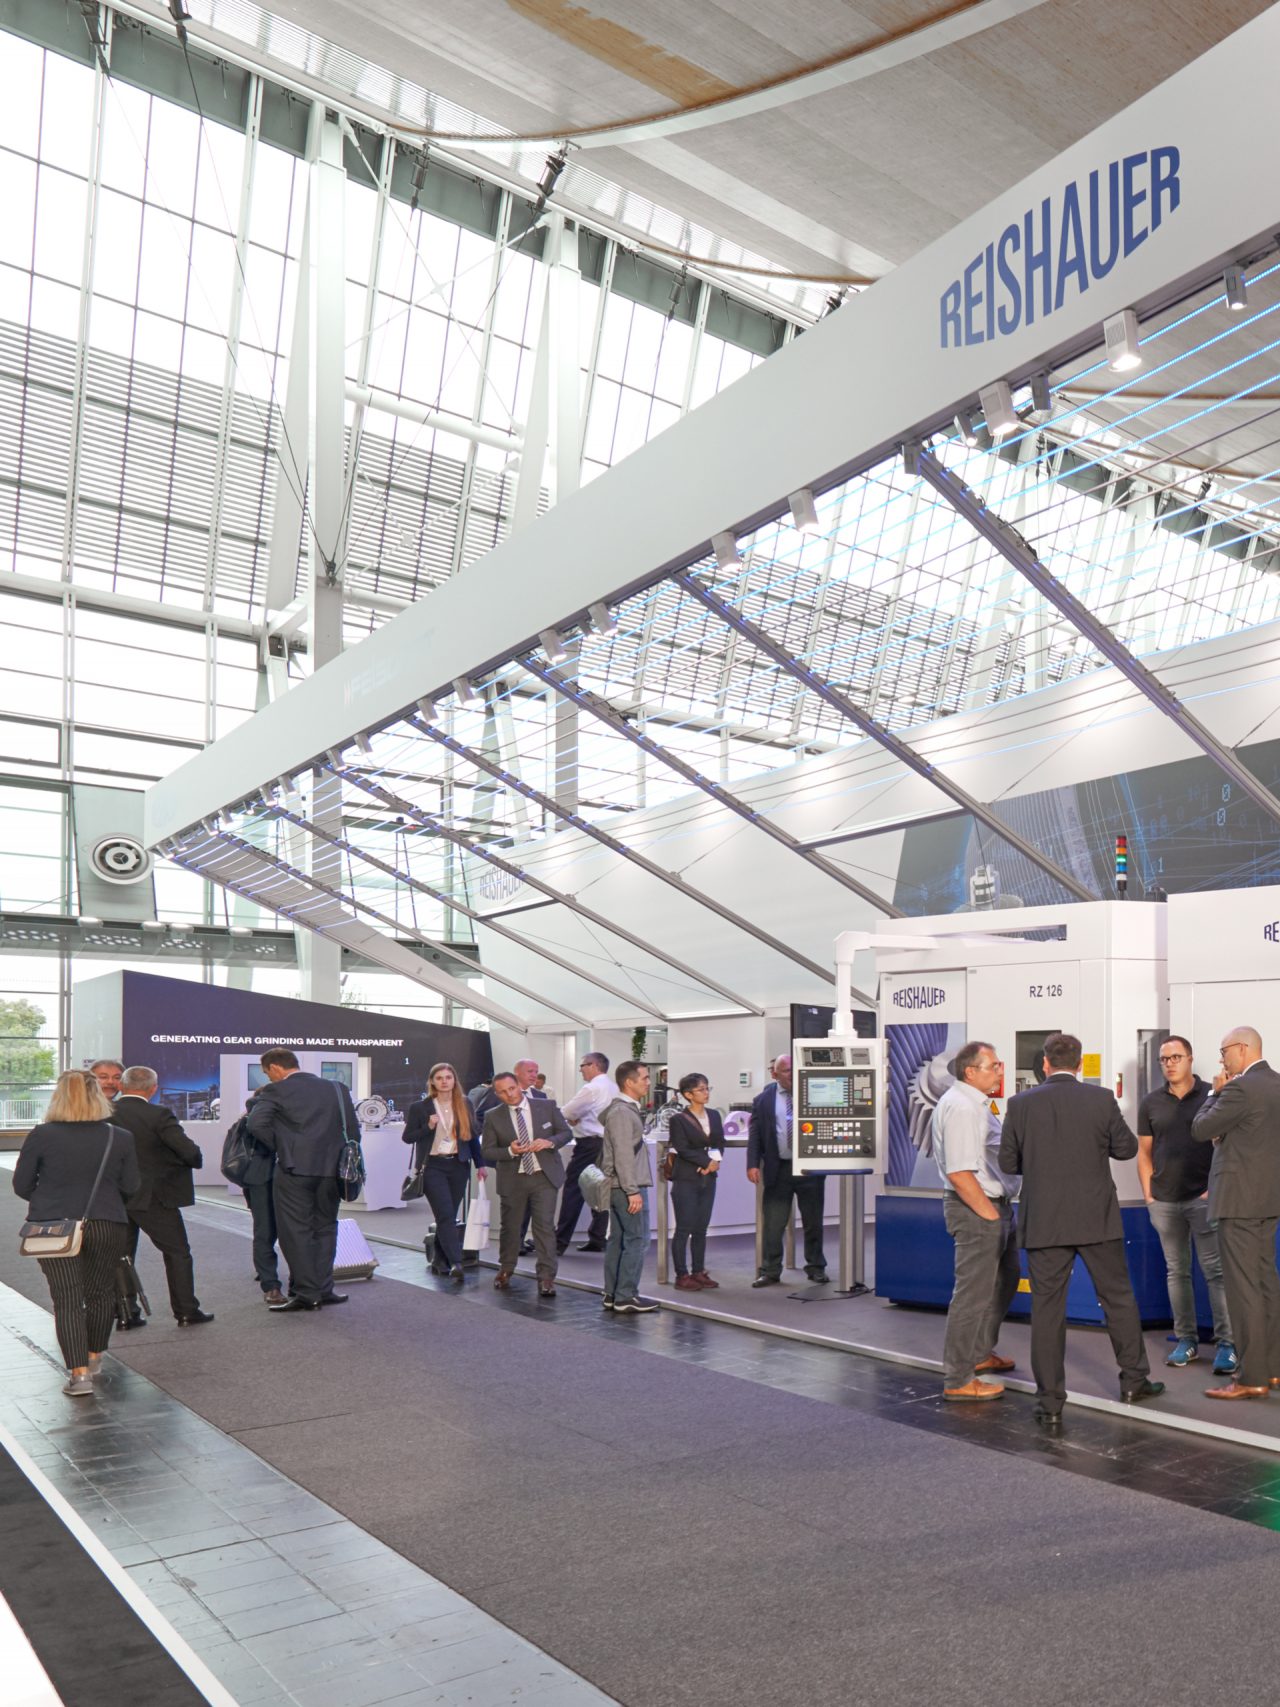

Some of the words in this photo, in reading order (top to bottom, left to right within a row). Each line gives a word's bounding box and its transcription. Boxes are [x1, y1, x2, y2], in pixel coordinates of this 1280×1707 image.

[940, 146, 1181, 348] REISHAUER
[893, 986, 945, 1009] REISHAUER
[1030, 985, 1043, 997] RZ
[1046, 984, 1062, 997] 126
[151, 1034, 221, 1044] GENERATING
[223, 1036, 252, 1044] GEAR
[254, 1037, 304, 1045] GRINDING
[306, 1037, 335, 1046] MADE
[336, 1038, 404, 1047] TRANSPARENT
